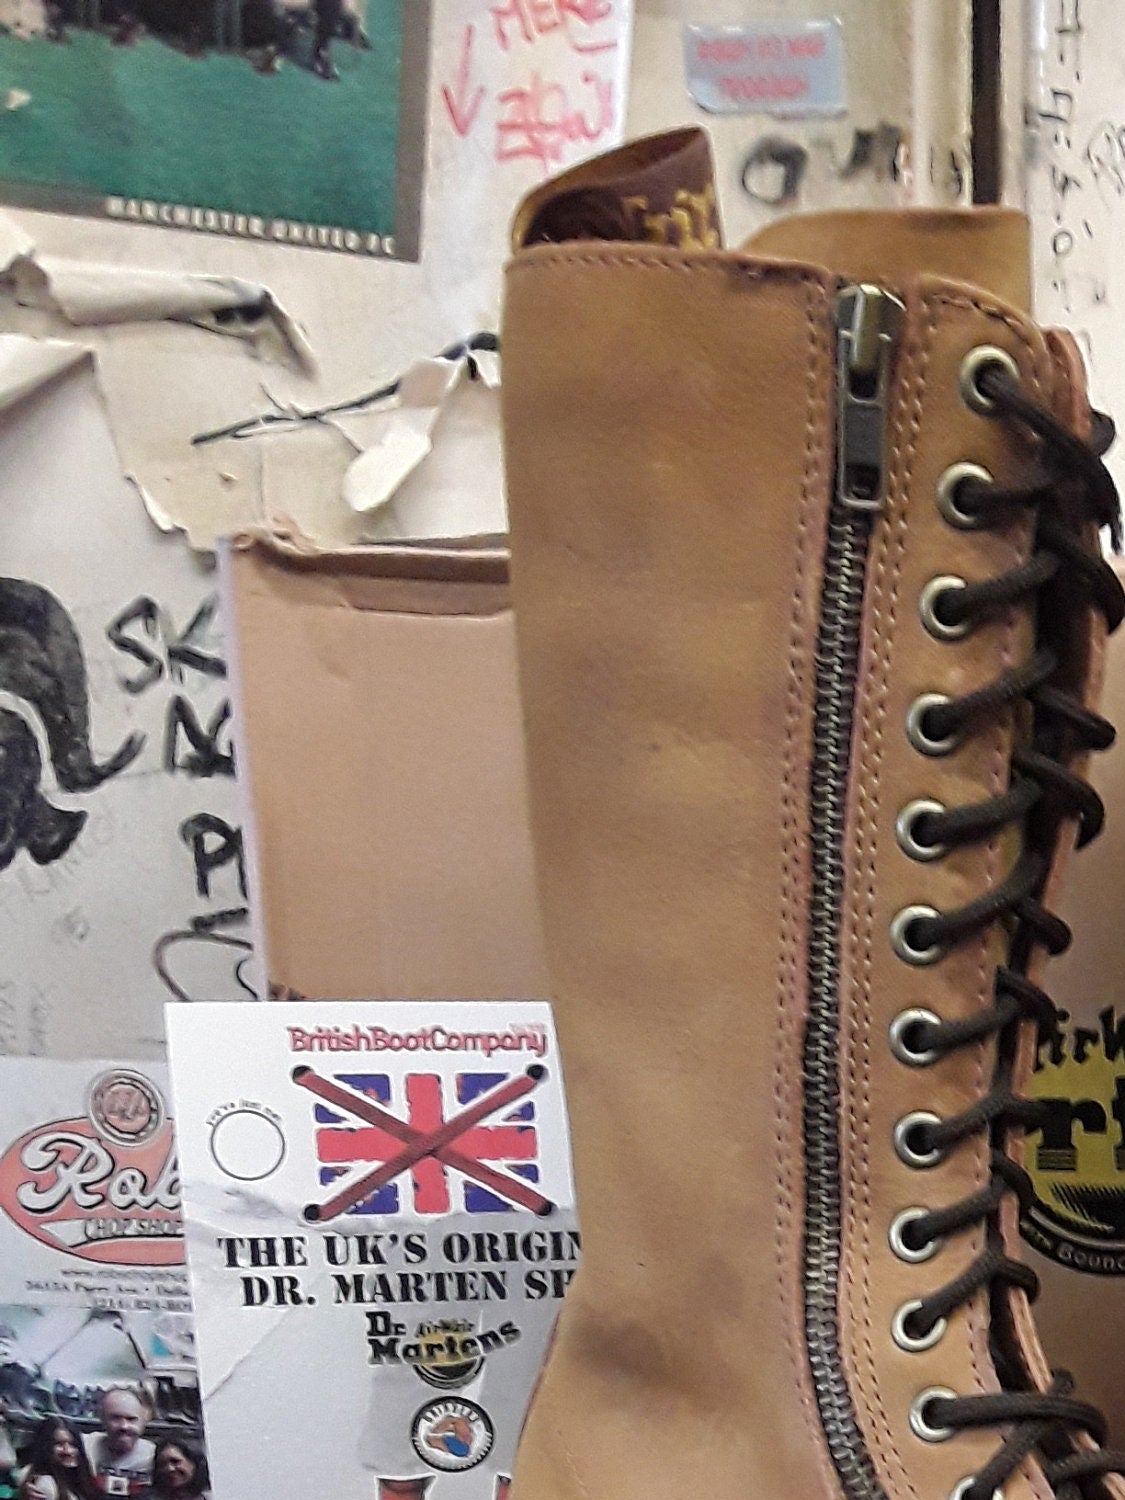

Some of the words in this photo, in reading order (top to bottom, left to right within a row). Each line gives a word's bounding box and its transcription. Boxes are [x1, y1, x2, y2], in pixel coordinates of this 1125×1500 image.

[105, 195, 265, 238] MANCHESTER
[271, 217, 362, 253] UNITED
[287, 1026, 546, 1058] BritishBootCompany
[217, 1237, 306, 1268] THE
[323, 1235, 427, 1266] UK'S
[241, 1276, 316, 1307] DR.
[333, 1271, 507, 1304] MARTEN
[368, 1321, 521, 1365] Martens
